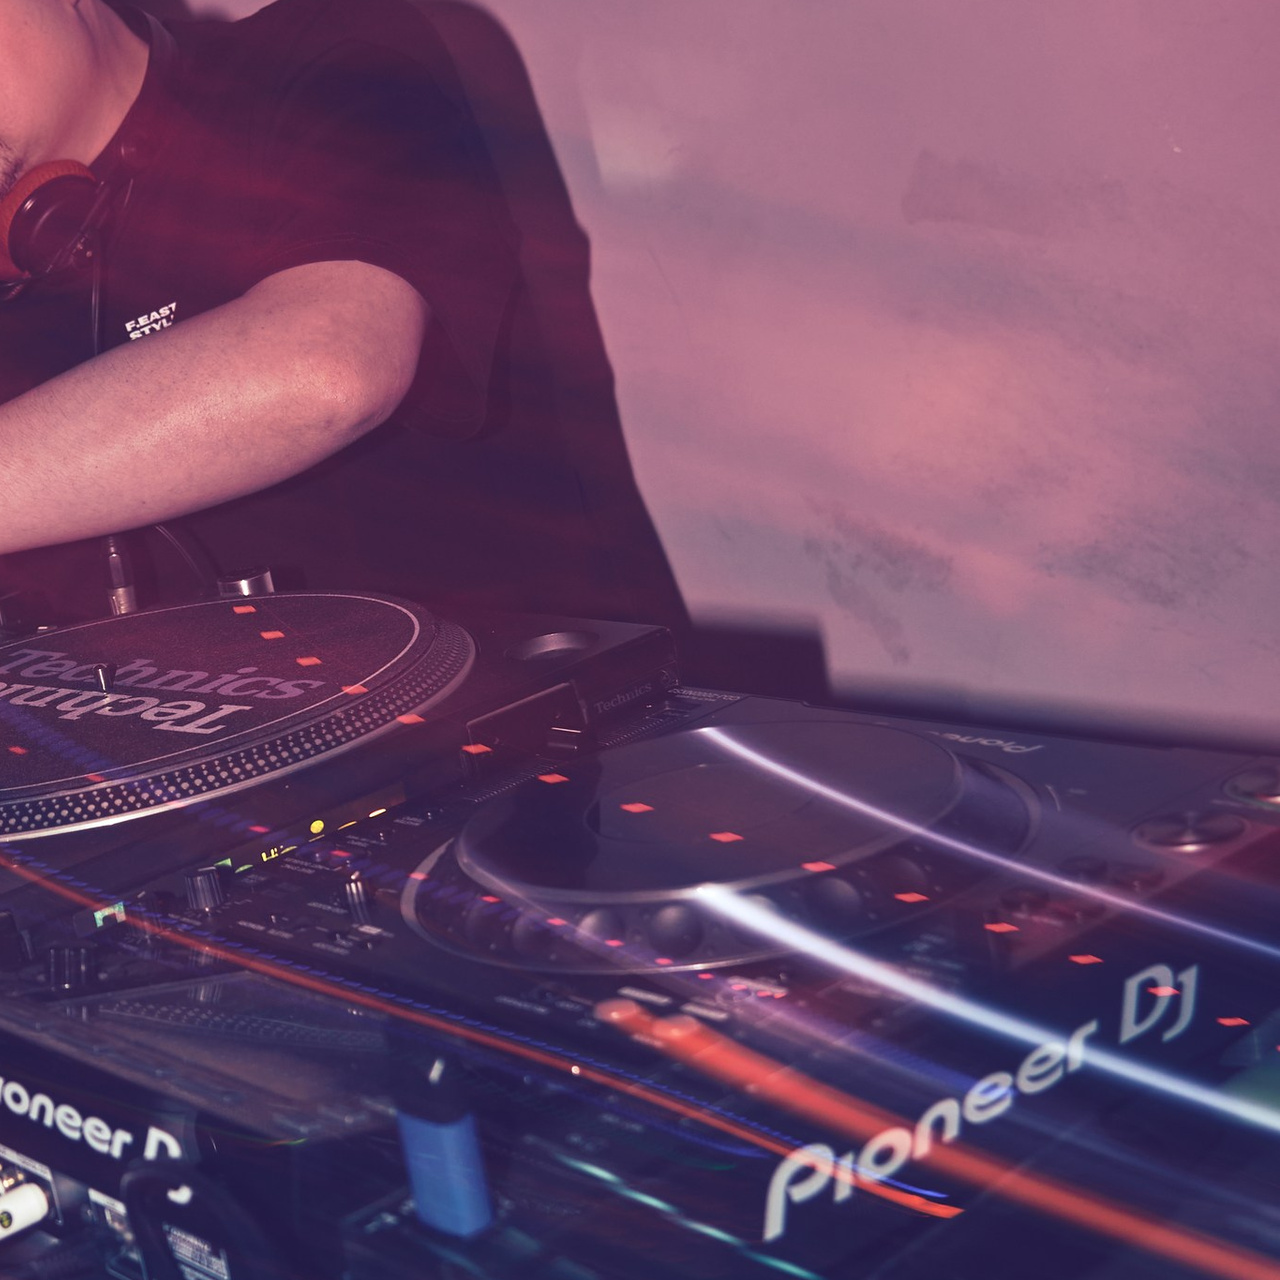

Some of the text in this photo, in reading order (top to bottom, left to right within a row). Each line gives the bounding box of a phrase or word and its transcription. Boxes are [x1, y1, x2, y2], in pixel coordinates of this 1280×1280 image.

[129, 314, 173, 340] STYL
[593, 682, 653, 715] Technics
[763, 963, 1199, 1243] Pioneer DJ
